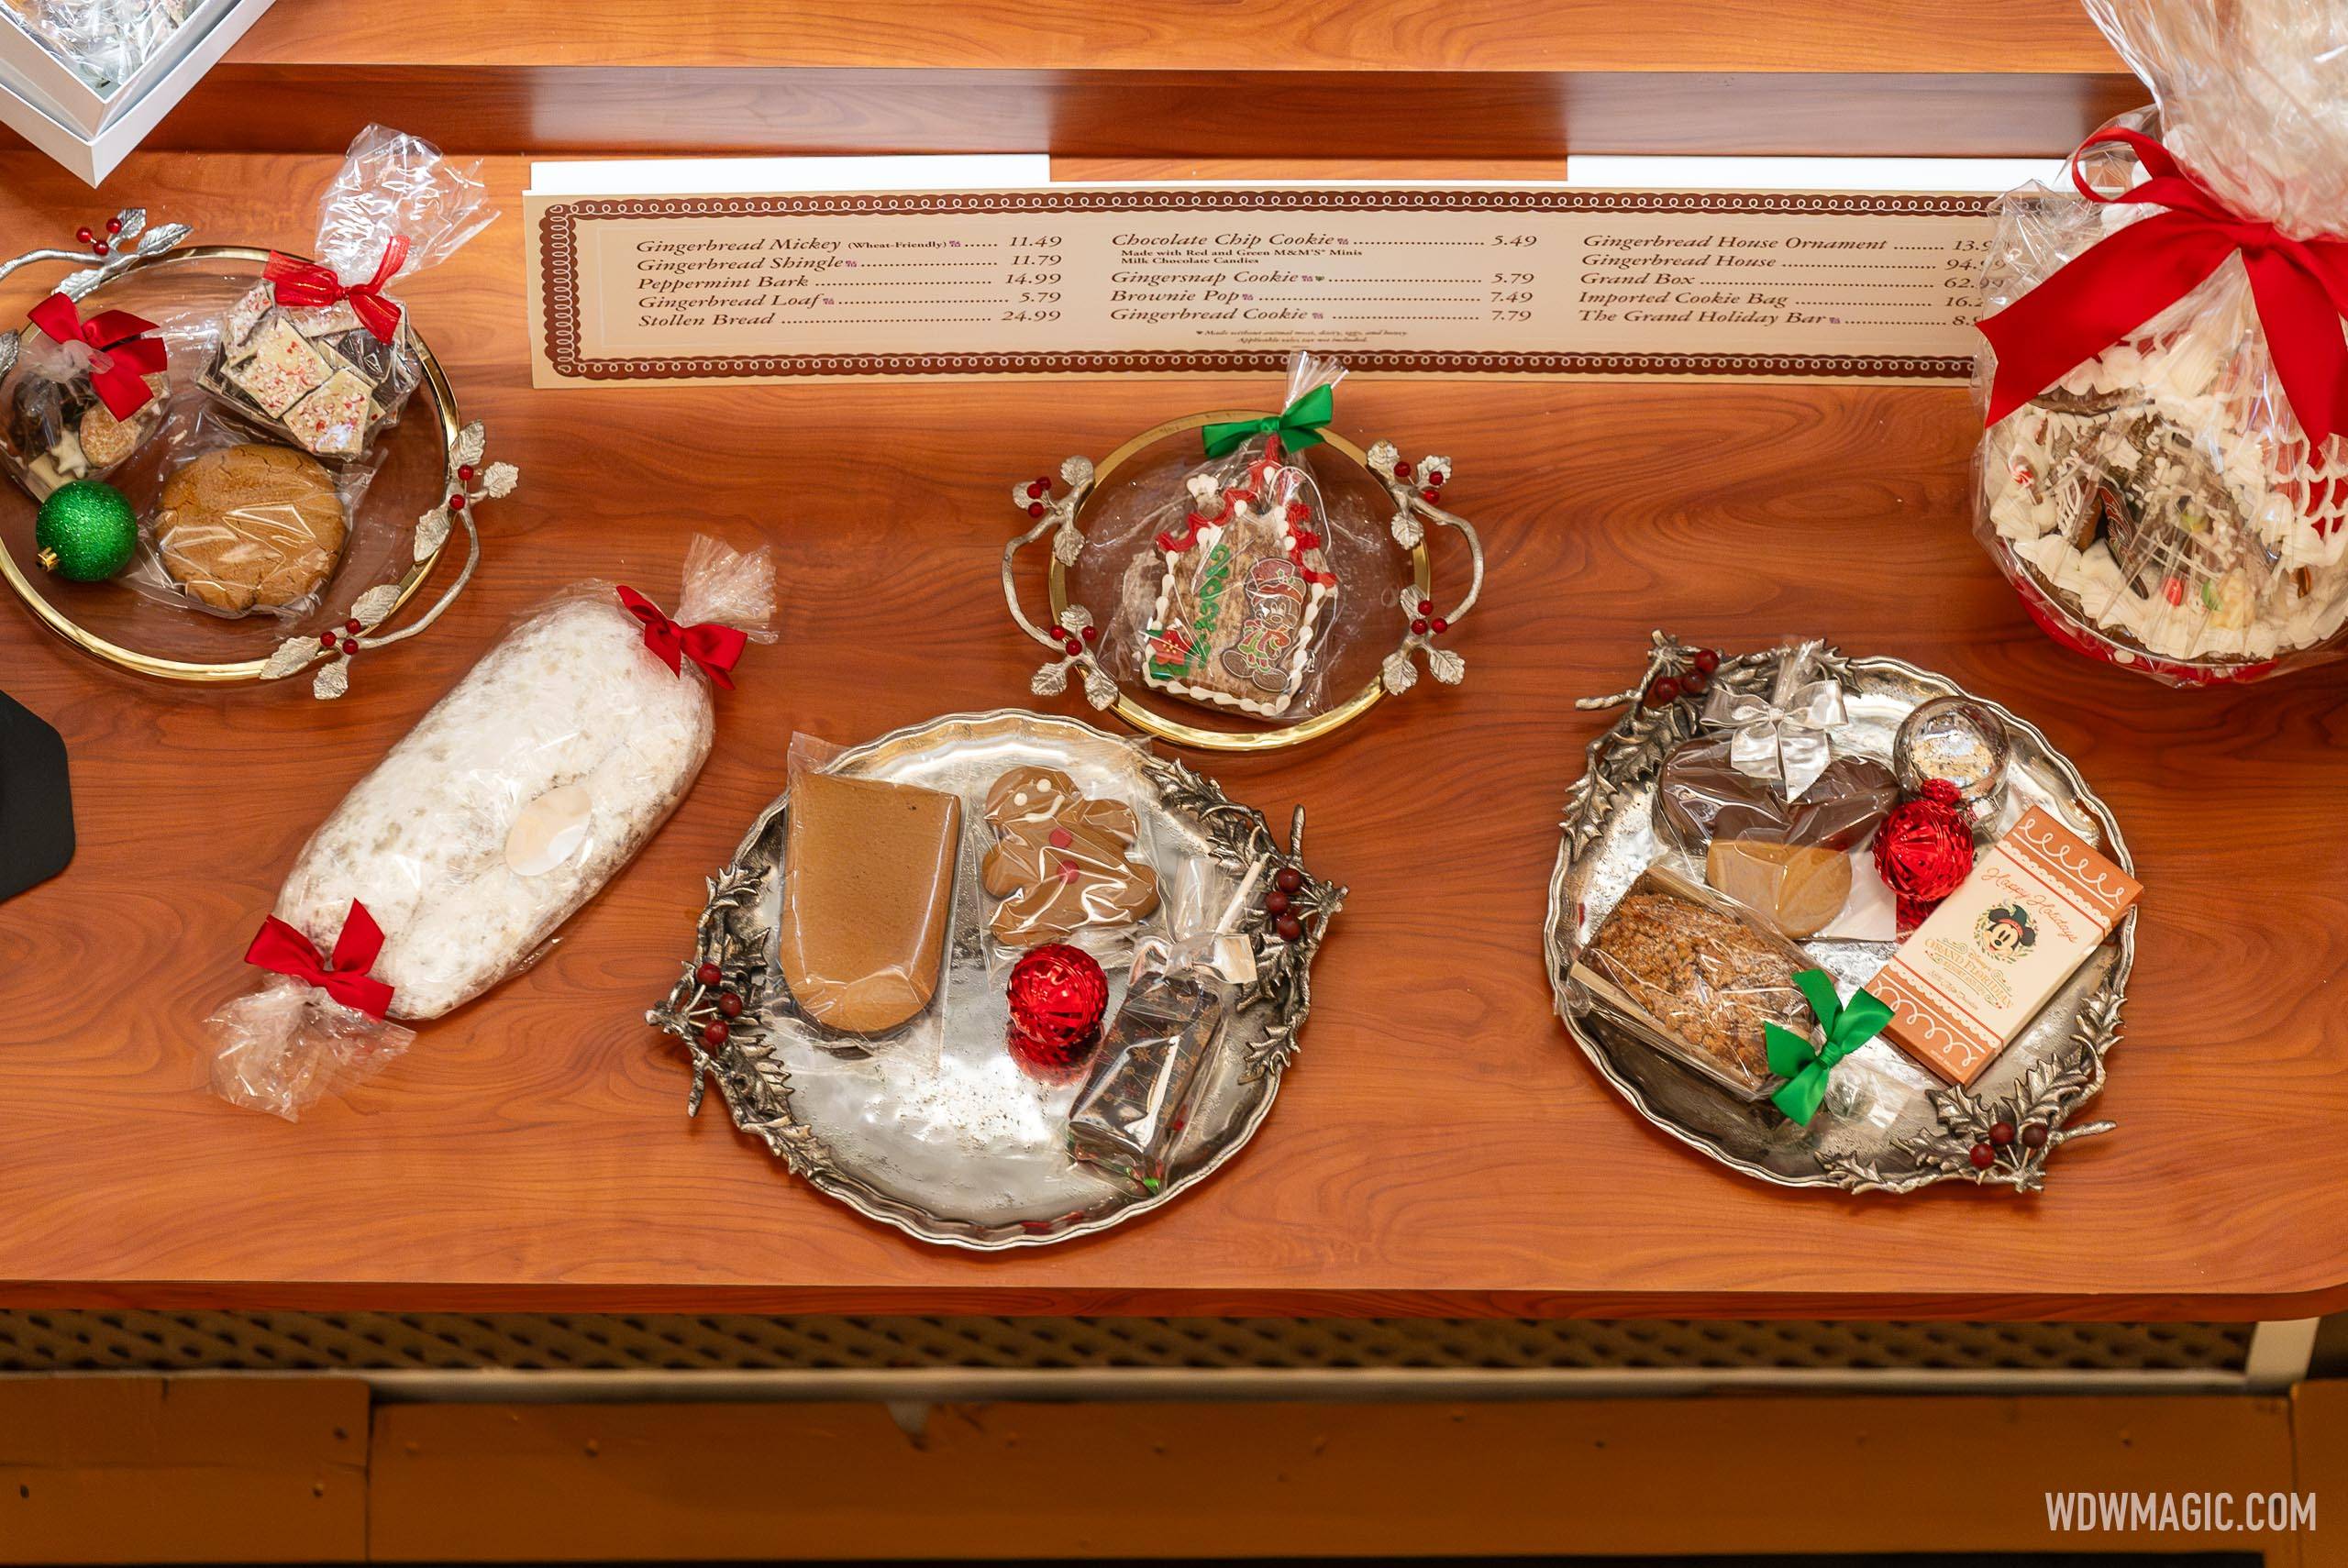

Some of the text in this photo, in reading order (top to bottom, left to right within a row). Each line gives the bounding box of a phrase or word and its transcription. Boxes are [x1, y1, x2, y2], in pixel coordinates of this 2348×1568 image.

[637, 236, 1062, 256] Gingerbread Mickey (Wheat-Friendly) 11.49
[1113, 233, 1536, 248] Chocolate Chip Cookie 5.49
[1584, 235, 1711, 250] Gingerbread
[1717, 237, 1778, 248] House
[1786, 237, 1888, 249] Ornament
[637, 255, 1061, 274] Gingerbread Shingle 11.79
[1582, 254, 1710, 270] Gingerbread
[1715, 256, 1776, 267] House
[637, 273, 1061, 293] Peppermint Bark 14.99
[1112, 271, 1534, 286] Gingersnap Cookie 5.79
[1580, 272, 1650, 284] Grand
[1654, 273, 1695, 284] Box
[638, 293, 1061, 312] Gingerbread Loaf 5.79
[1110, 290, 1533, 304] Brownie Pop 7.49
[1578, 292, 1670, 306] Imported
[1676, 292, 1740, 304] Cookie
[1747, 293, 1789, 308] Bag
[638, 311, 1060, 326] Stollen Bread 24.99
[1111, 308, 1532, 324] Gingerbread Cookie 7.79
[1579, 310, 1617, 321] The
[1623, 310, 1693, 322] Grand
[1698, 311, 1778, 326] Holiday
[1785, 313, 1830, 323] Bar
[1981, 868, 2078, 944] Happy Holidays
